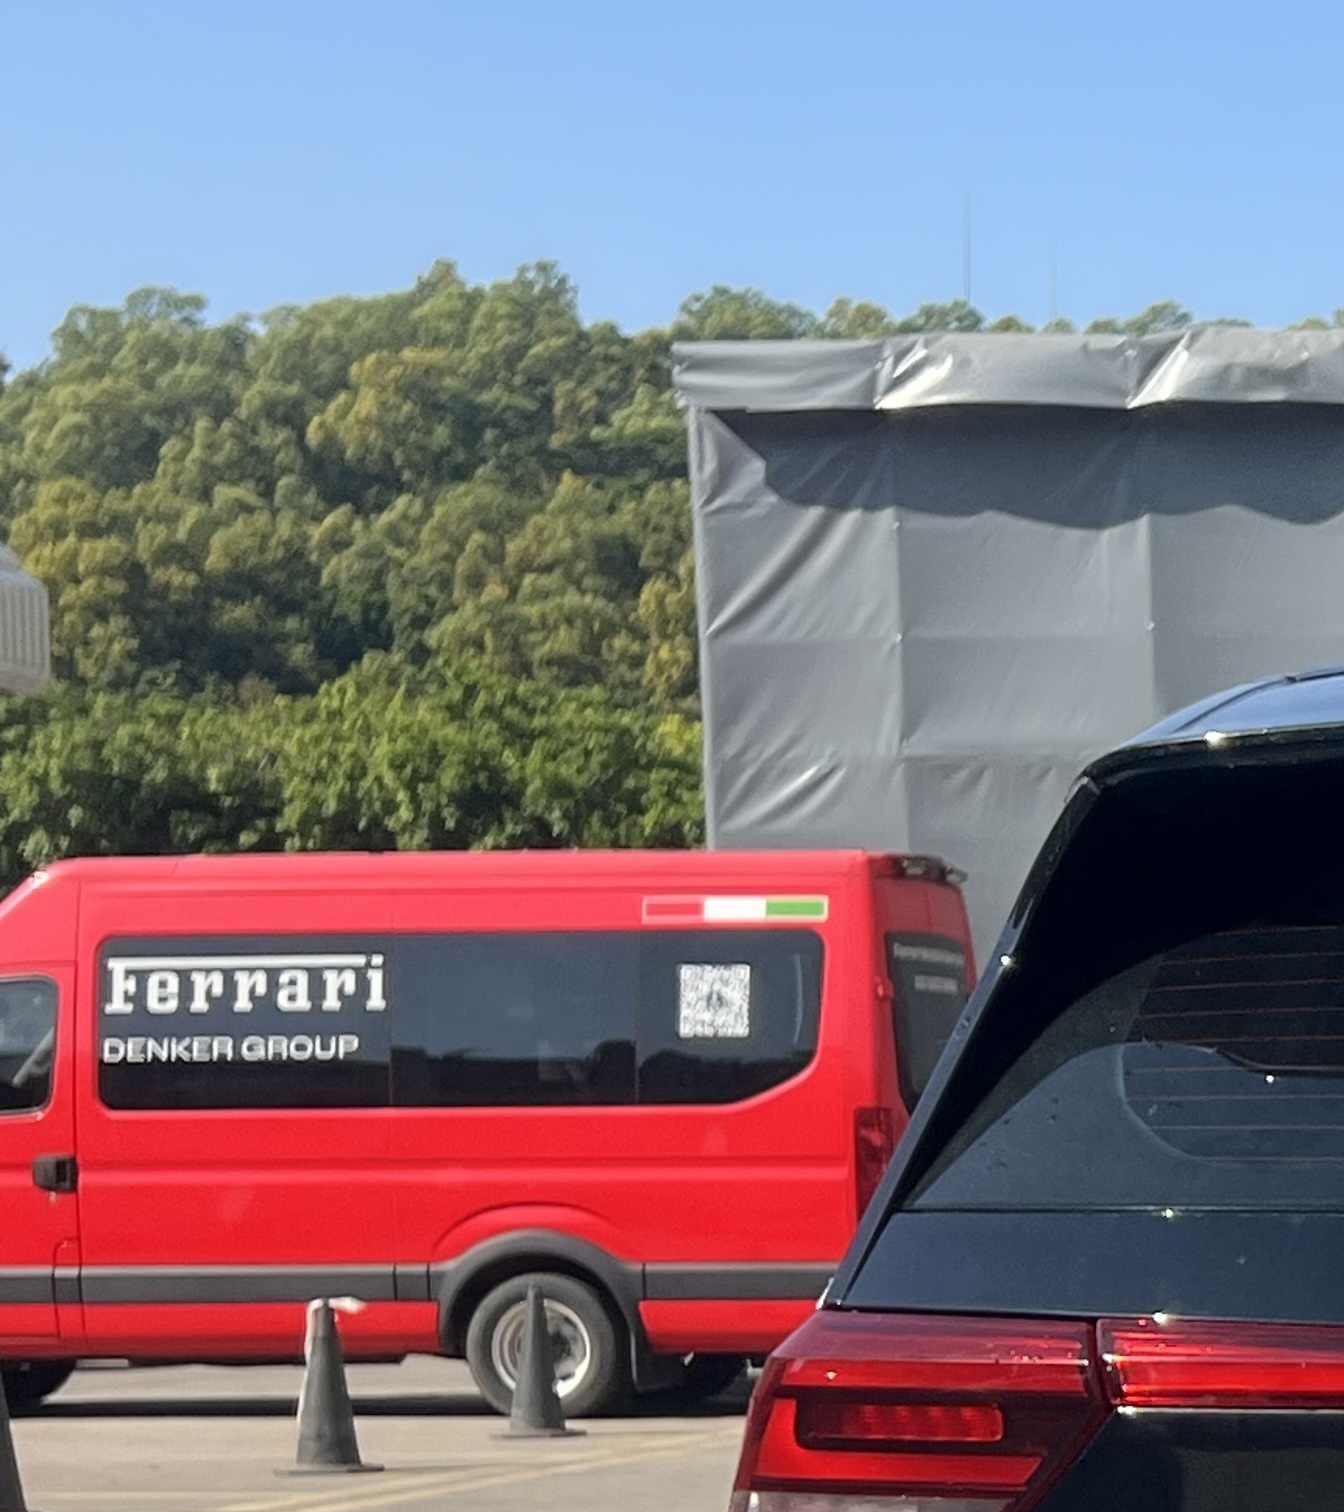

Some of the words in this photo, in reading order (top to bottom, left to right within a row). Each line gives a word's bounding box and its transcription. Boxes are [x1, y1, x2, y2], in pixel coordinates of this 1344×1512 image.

[103, 953, 388, 1015] Ferrari
[102, 1036, 233, 1063] DENKER
[240, 1034, 360, 1061] GROUP
